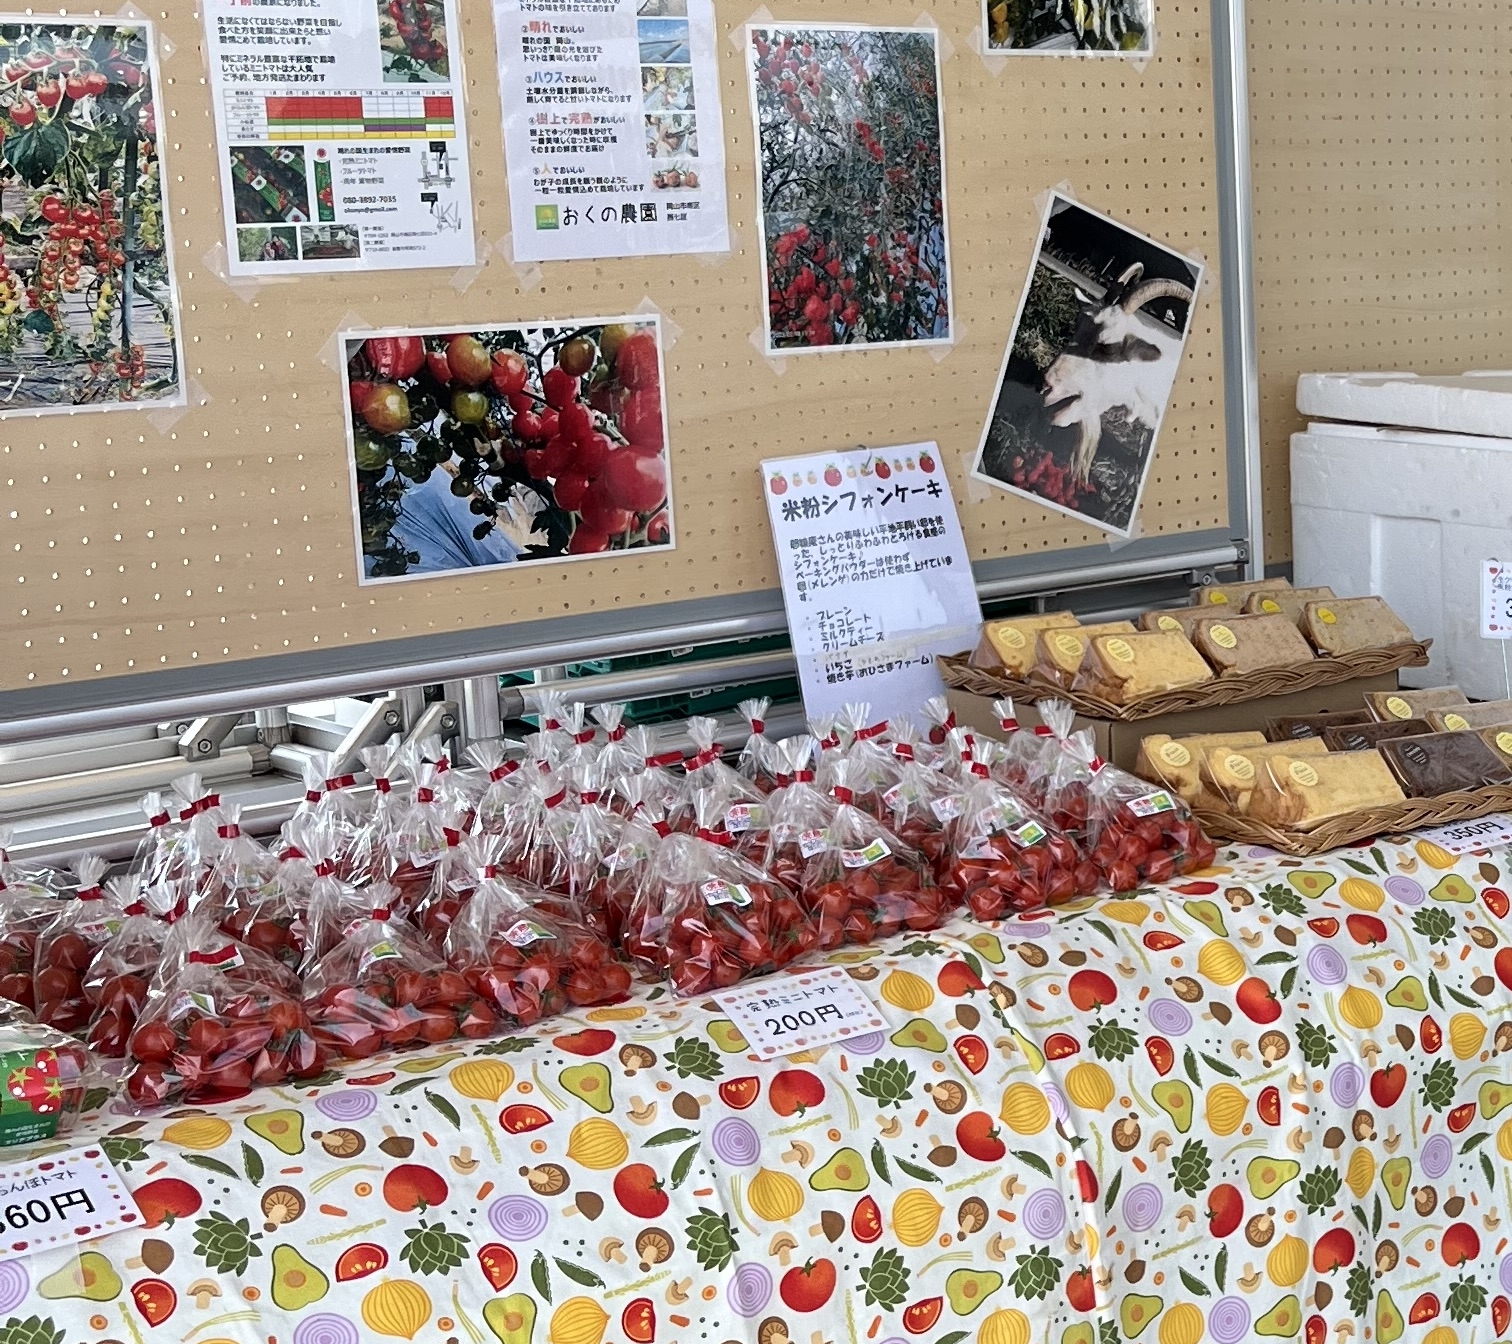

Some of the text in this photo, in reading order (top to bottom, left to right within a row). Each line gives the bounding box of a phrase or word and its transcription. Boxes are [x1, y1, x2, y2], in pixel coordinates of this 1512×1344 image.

[563, 203, 658, 226] おくの農園
[781, 479, 943, 522] 米粉シフォンケーキ
[818, 614, 872, 631] チョコレート
[820, 626, 873, 642] ミルクティー
[1443, 821, 1505, 840] 350円
[746, 984, 839, 1012] 完熟ミニトマト
[764, 1004, 845, 1036] 200円
